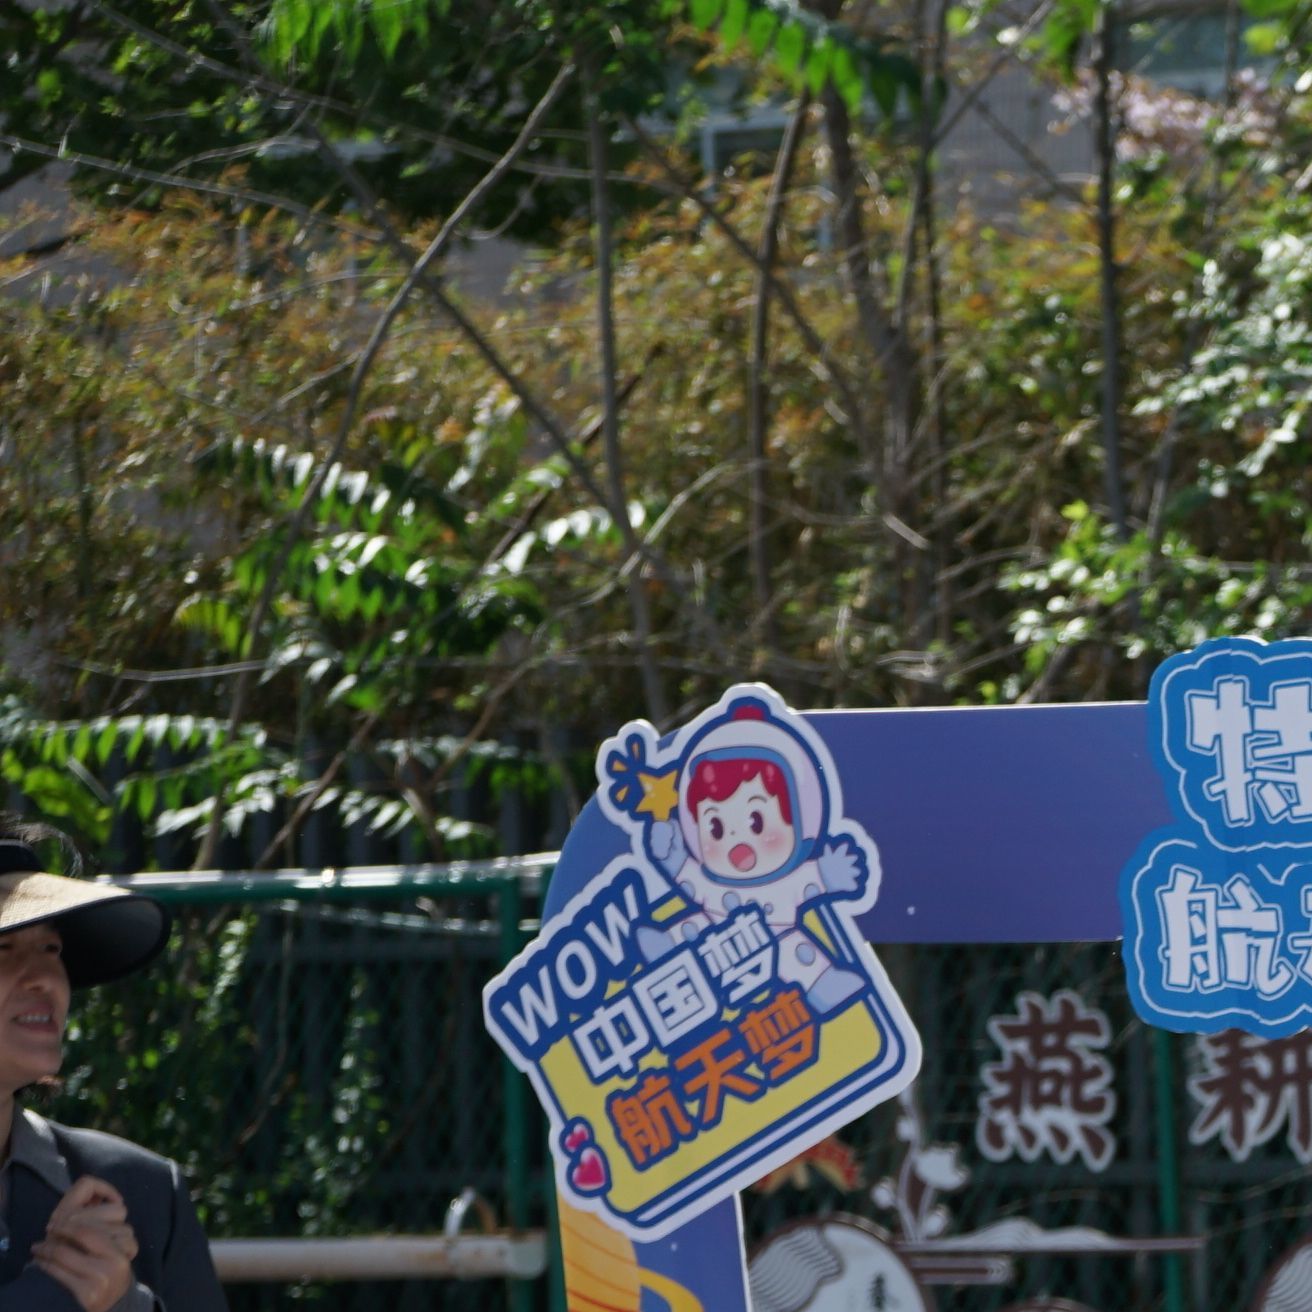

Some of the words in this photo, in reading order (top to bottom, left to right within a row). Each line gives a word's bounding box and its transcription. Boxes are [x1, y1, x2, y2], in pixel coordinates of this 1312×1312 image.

[501, 883, 640, 1047] WOW
[572, 910, 776, 1079] 中国梦
[611, 988, 816, 1165] 航天梦
